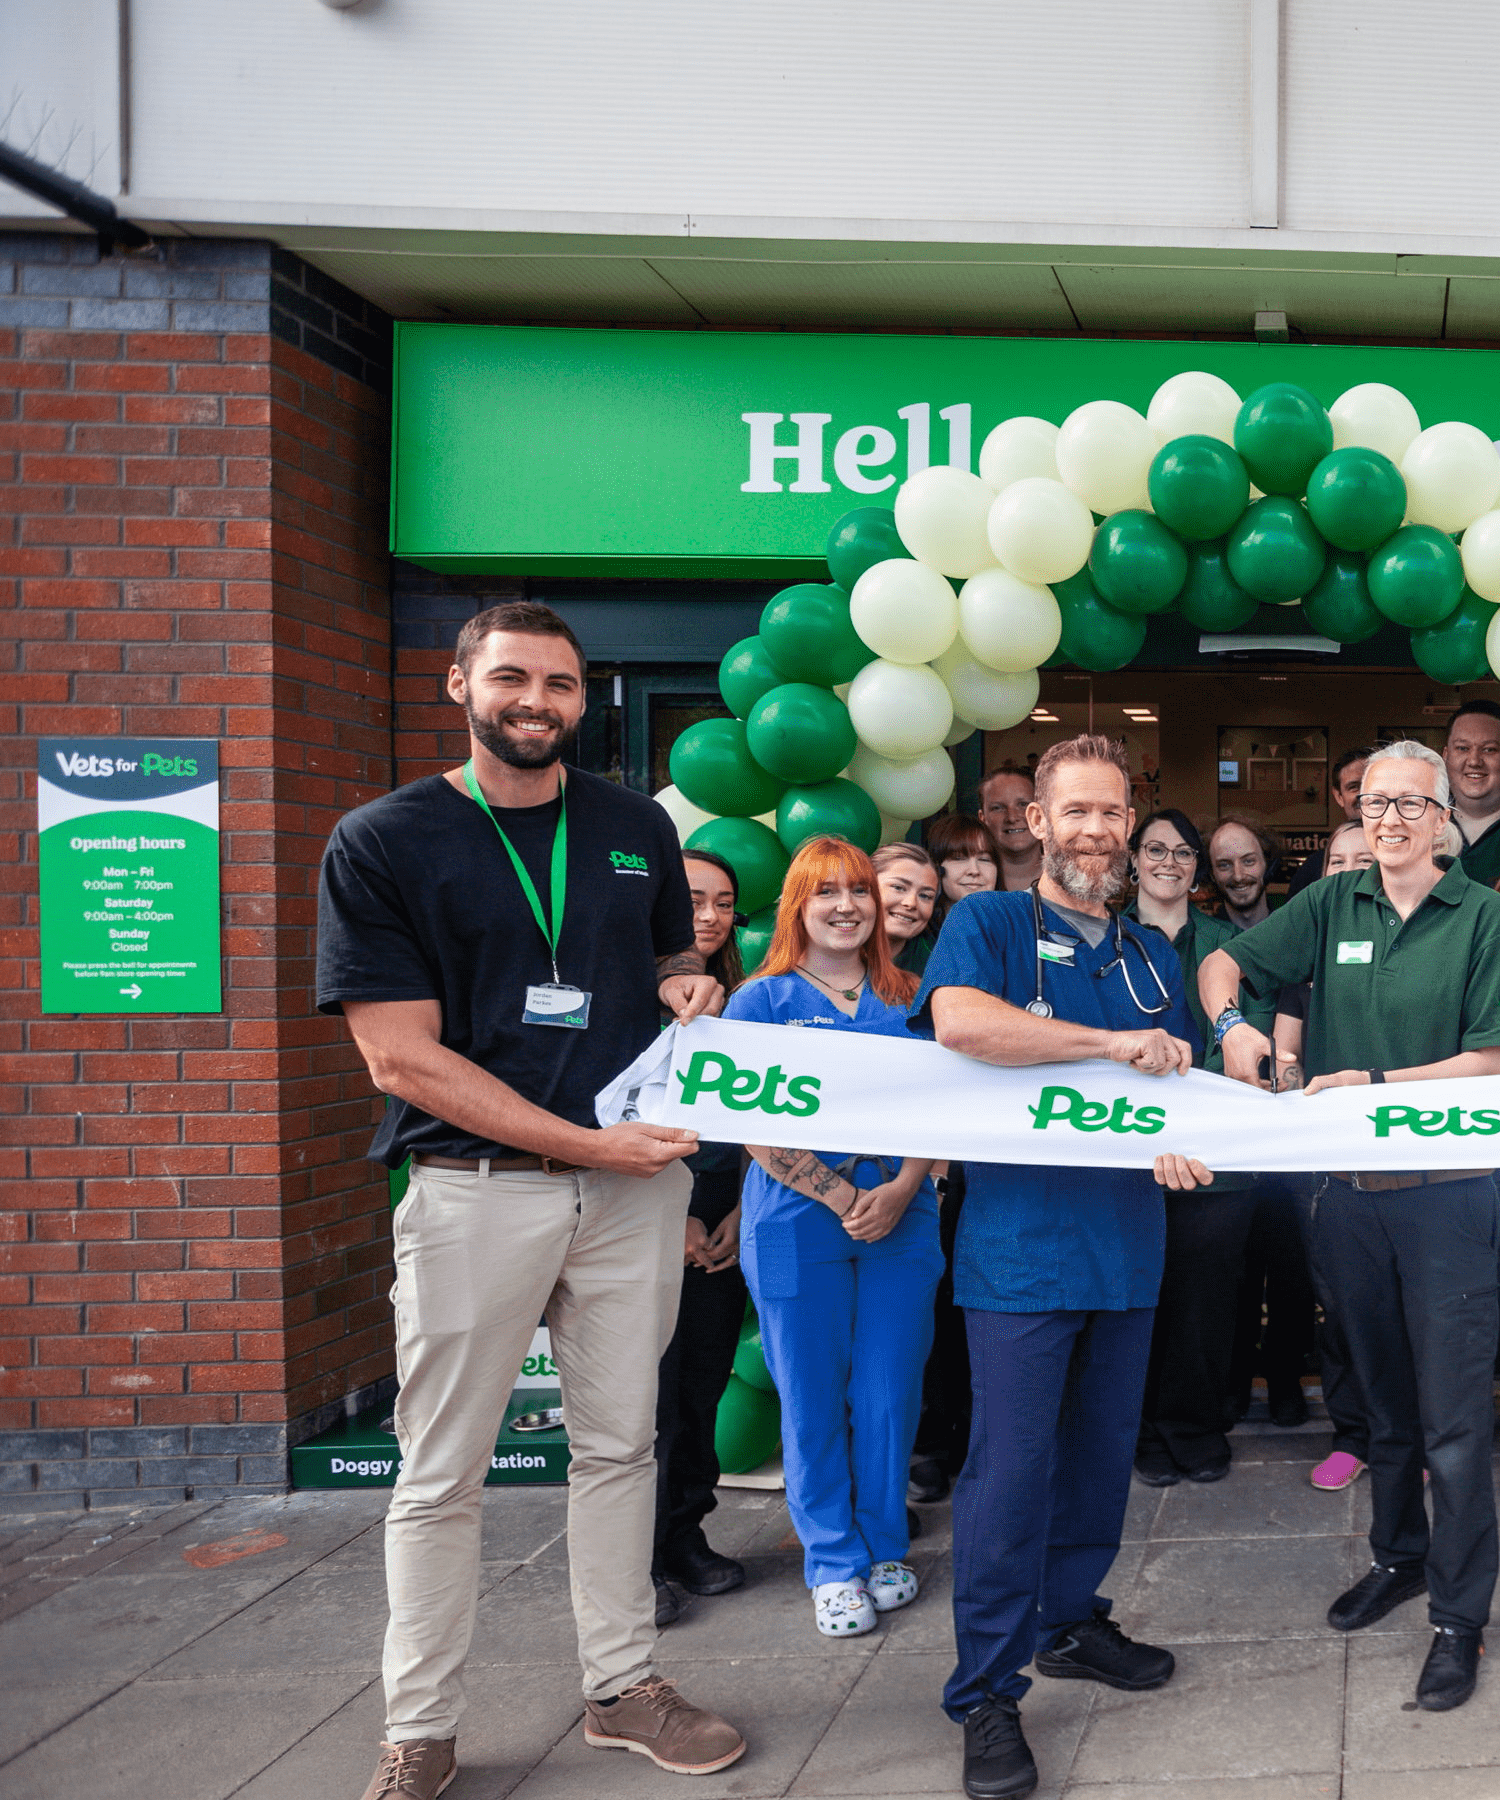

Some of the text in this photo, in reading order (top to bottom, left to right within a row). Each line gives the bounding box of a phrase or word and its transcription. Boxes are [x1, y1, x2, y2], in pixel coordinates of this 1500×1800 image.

[741, 402, 972, 494] Hell
[56, 751, 199, 777] Vets for Pets
[70, 836, 186, 852] Opening hours
[609, 850, 648, 870] Pets
[103, 866, 128, 877] Mon
[139, 866, 155, 877] Fri
[82, 880, 174, 892] 9:00am 7:00pm
[104, 898, 154, 909] Saturday
[83, 911, 124, 921] 9:00am
[134, 911, 174, 922] 4:00pm
[109, 928, 150, 940] Sunday
[111, 942, 148, 952] Closed
[564, 1015, 584, 1025] Pets
[812, 1015, 835, 1025] Pets
[676, 1051, 822, 1118] Pets
[1027, 1086, 1166, 1135] Pets
[521, 1353, 559, 1377] ets
[331, 1458, 394, 1476] Doggy
[491, 1453, 546, 1470] tation
